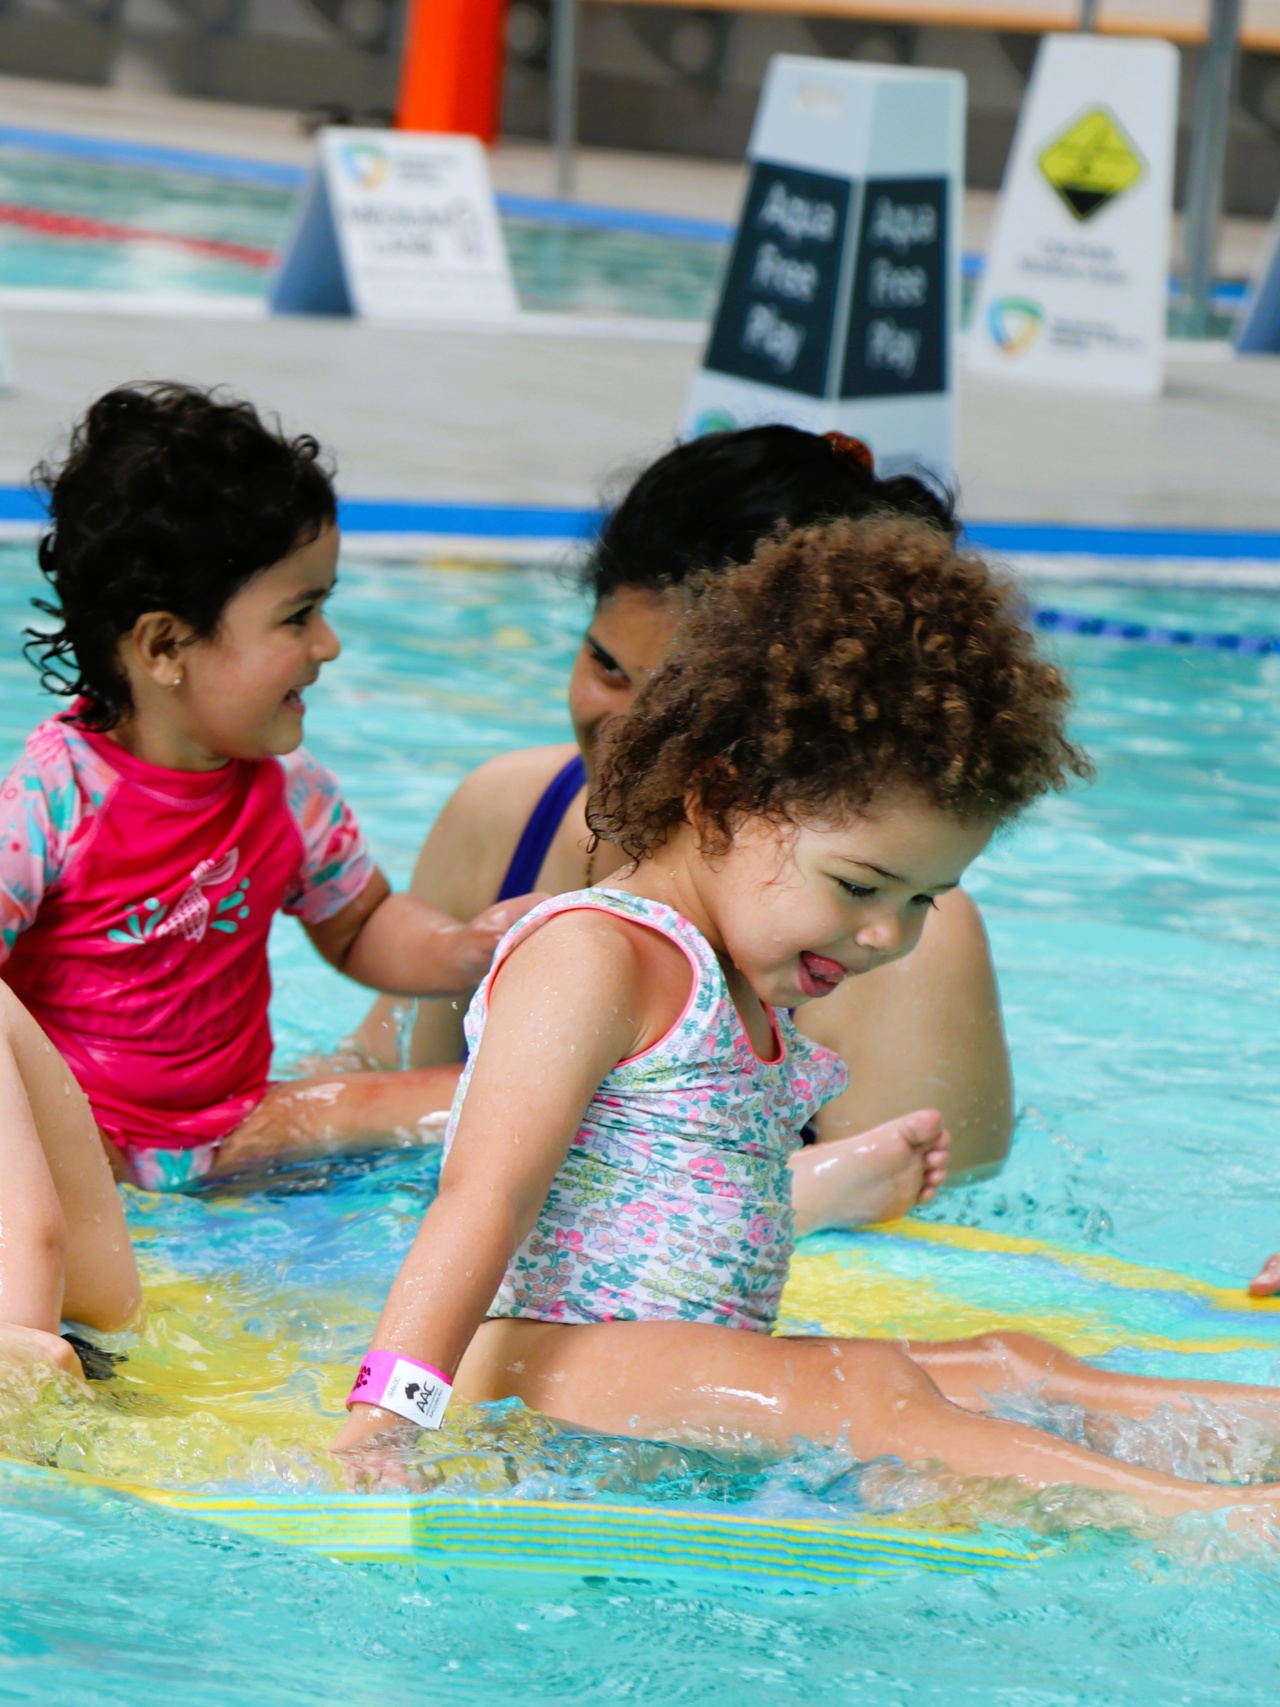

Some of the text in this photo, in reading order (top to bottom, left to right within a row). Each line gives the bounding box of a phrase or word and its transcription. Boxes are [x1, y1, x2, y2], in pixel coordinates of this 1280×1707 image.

[757, 179, 836, 245] Aqua
[871, 196, 937, 251] Aqua
[750, 243, 818, 304] Free
[416, 1381, 436, 1414] AAC
